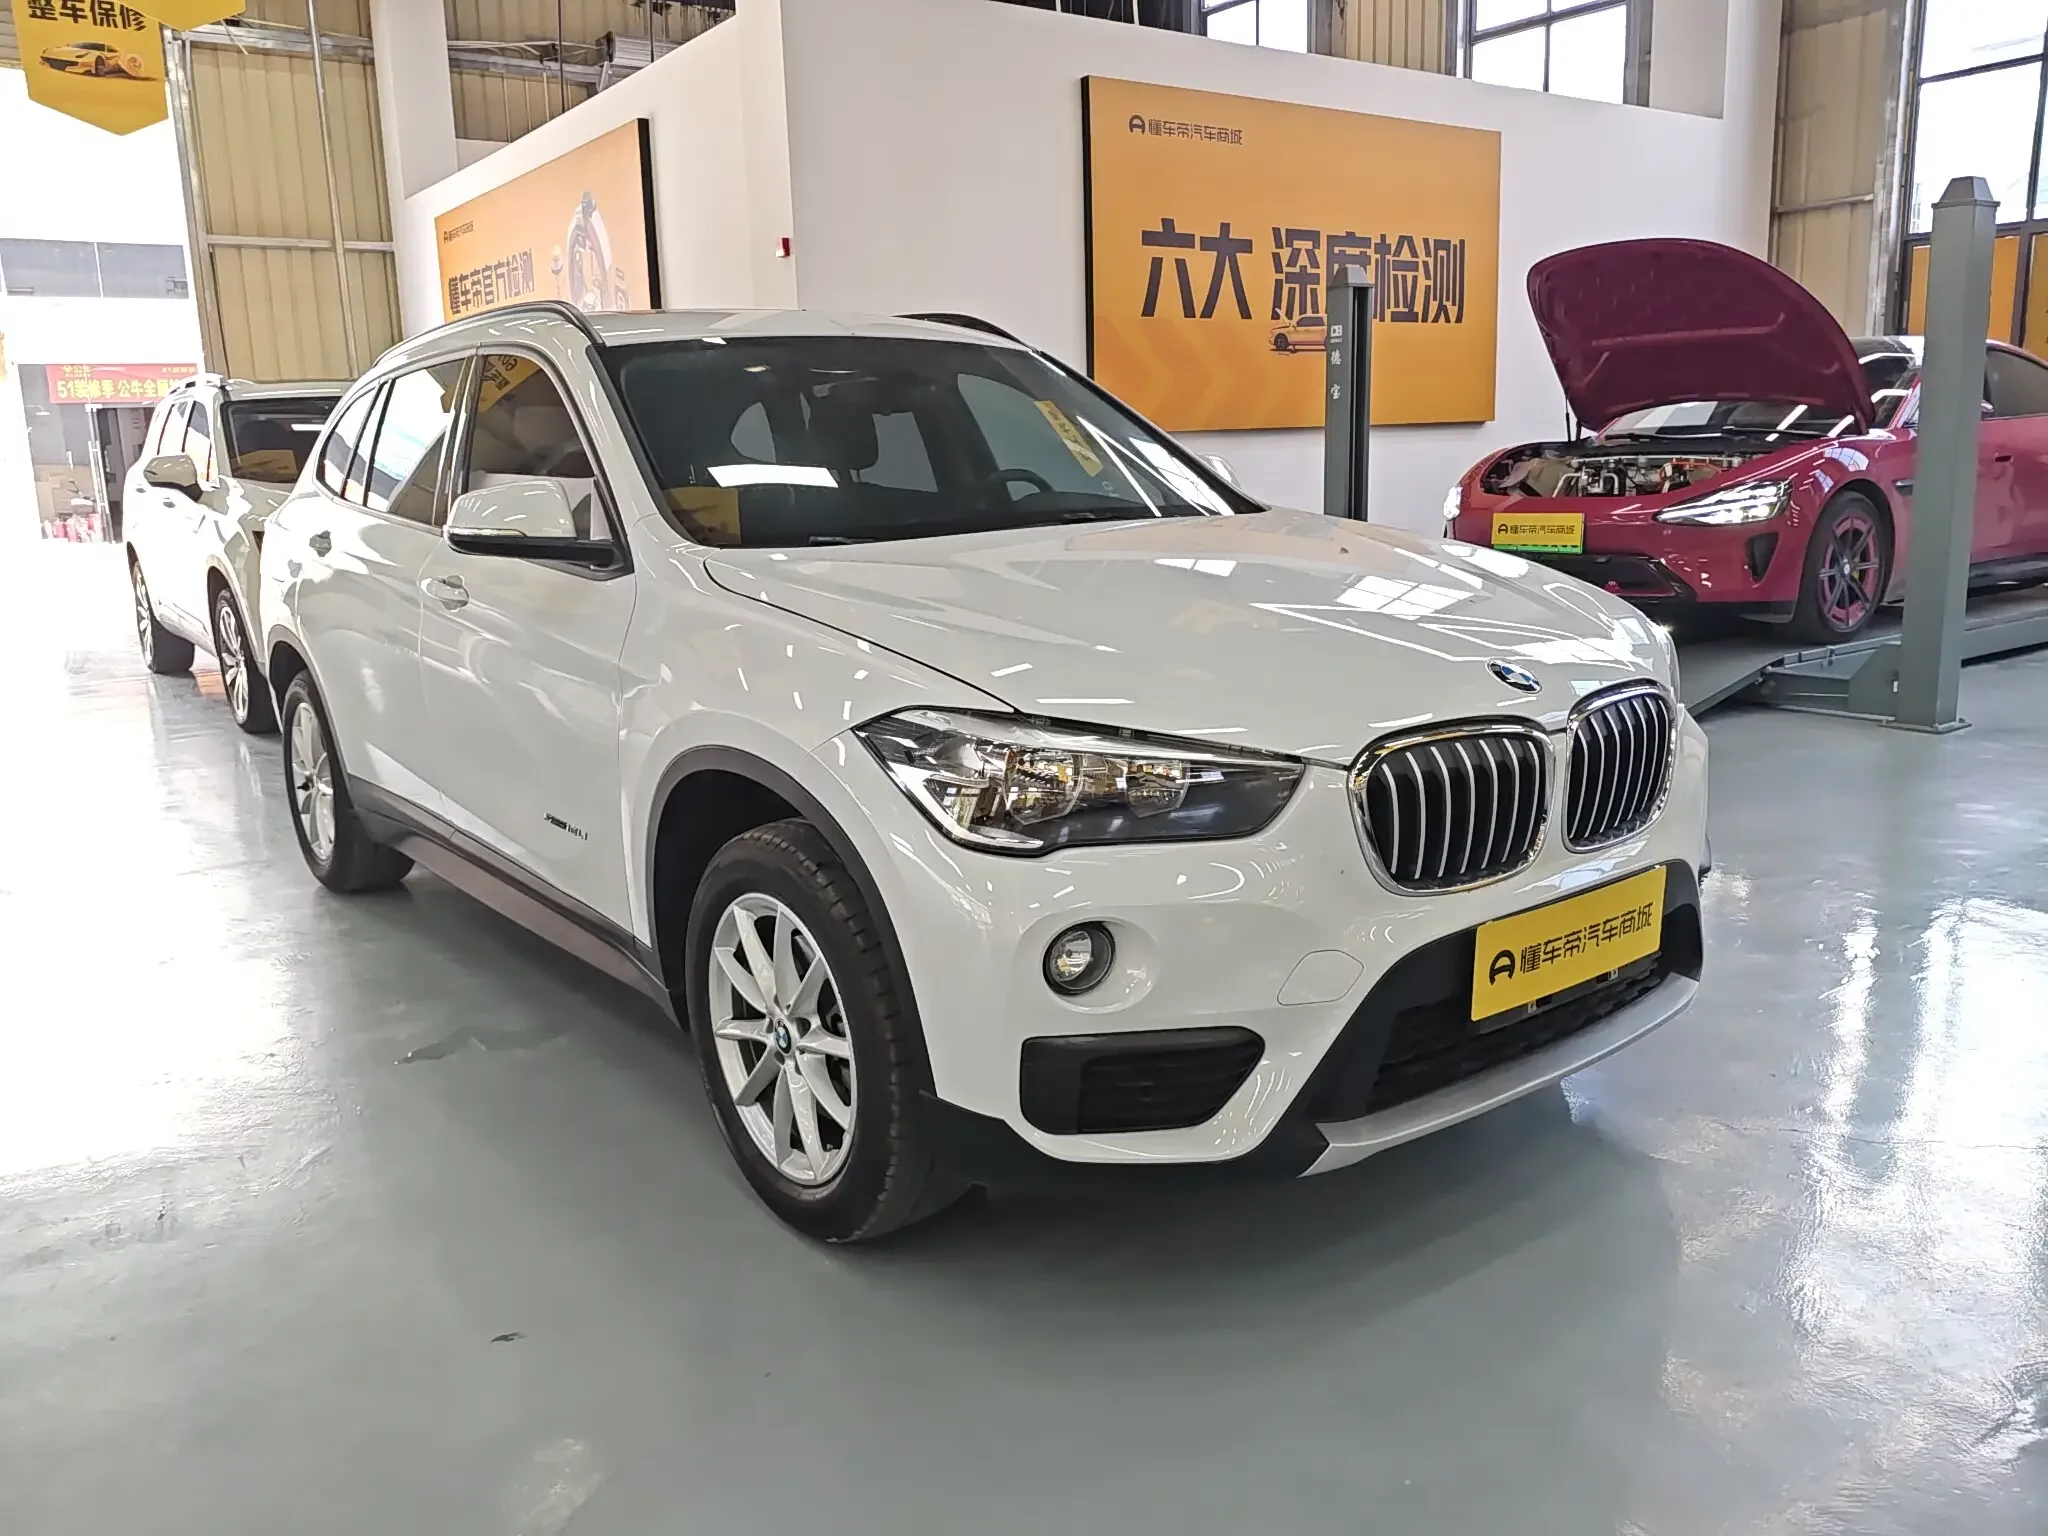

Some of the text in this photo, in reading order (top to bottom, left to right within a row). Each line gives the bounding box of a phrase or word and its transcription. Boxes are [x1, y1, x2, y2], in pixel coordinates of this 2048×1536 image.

[28, 0, 147, 31] 整车保修
[1148, 119, 1242, 145] 懂车帝汽车商城
[448, 248, 535, 315] 懂车帝官方检测
[1141, 218, 1253, 320] 六大
[1509, 524, 1576, 535] 懂车帝汽车商城
[1519, 901, 1653, 974] 懂车帝汽车商城
